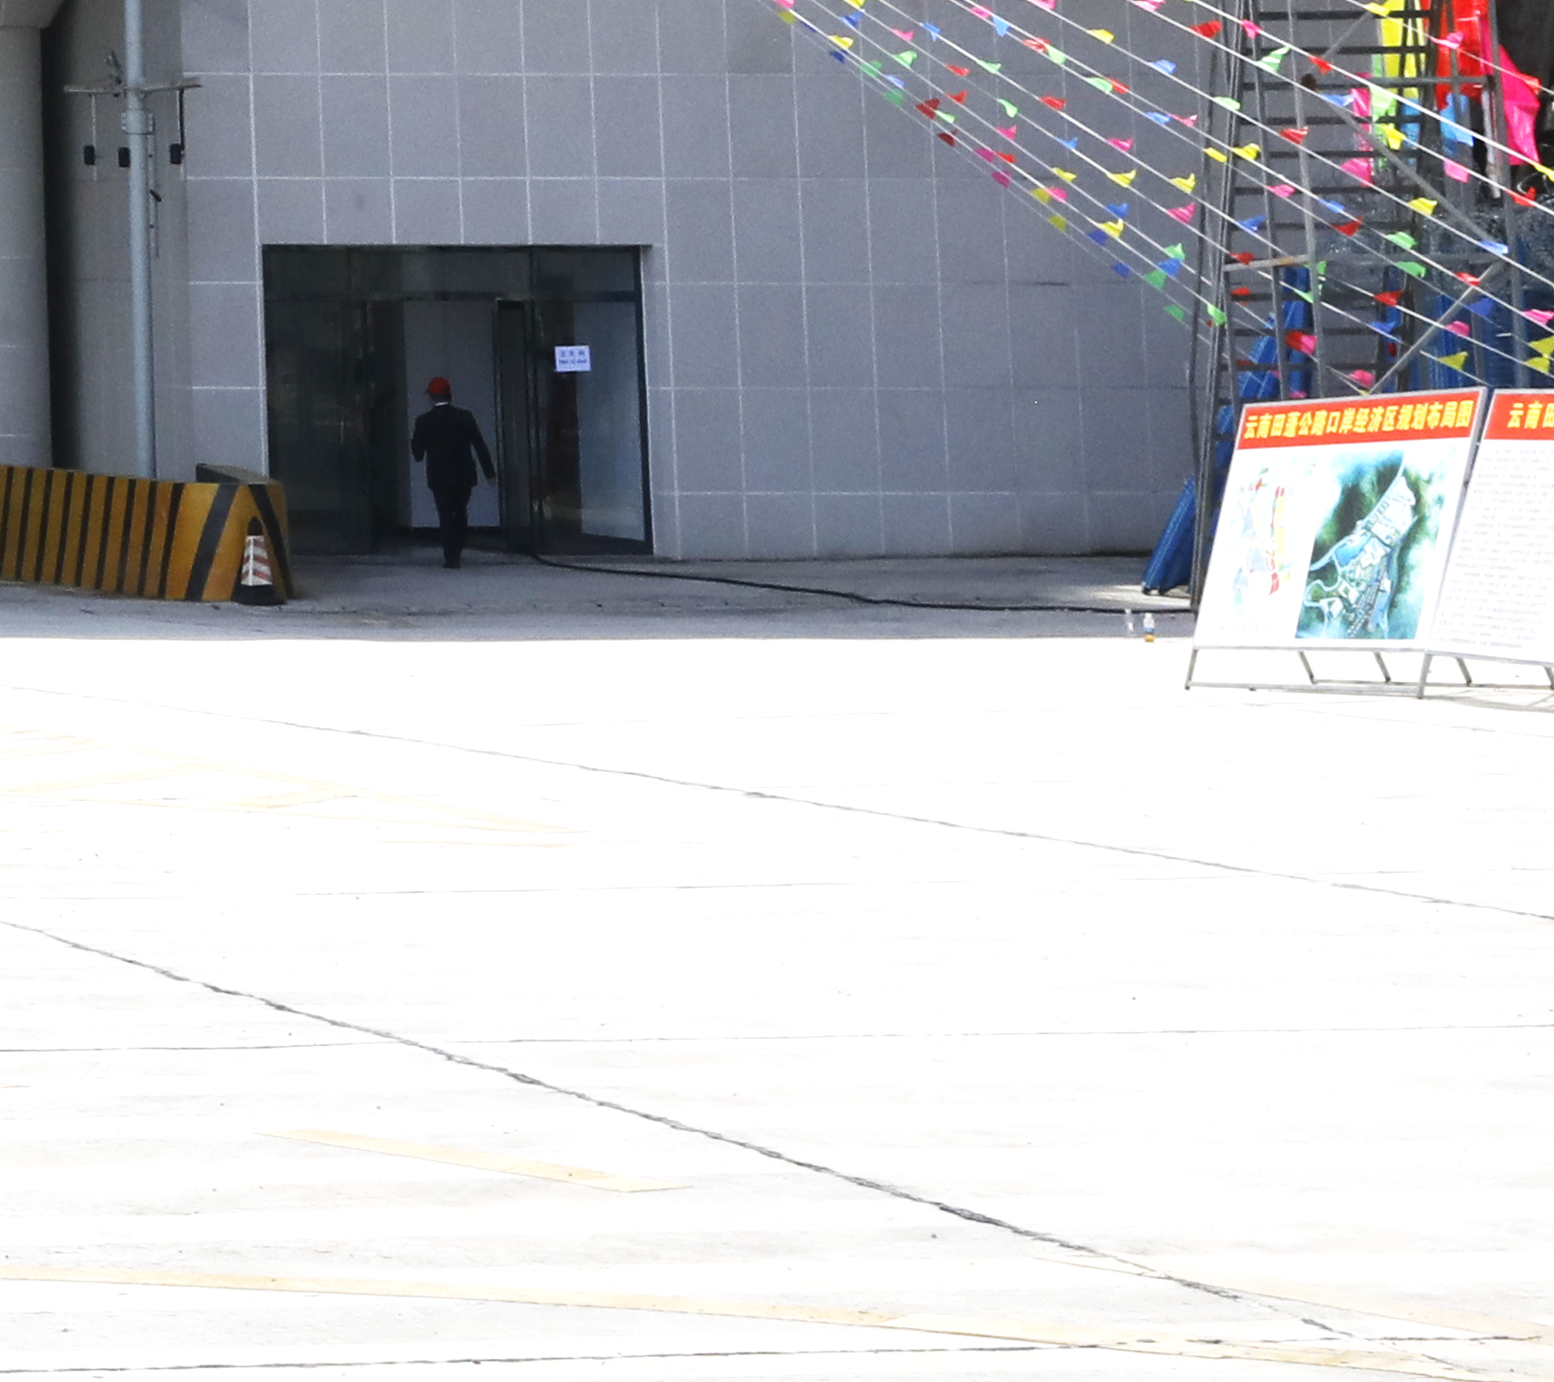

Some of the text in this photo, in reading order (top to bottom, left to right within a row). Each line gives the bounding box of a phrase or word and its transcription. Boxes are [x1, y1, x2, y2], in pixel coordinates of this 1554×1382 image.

[1244, 400, 1475, 439] 云南田蓬公路口岸经济区规划布局图
